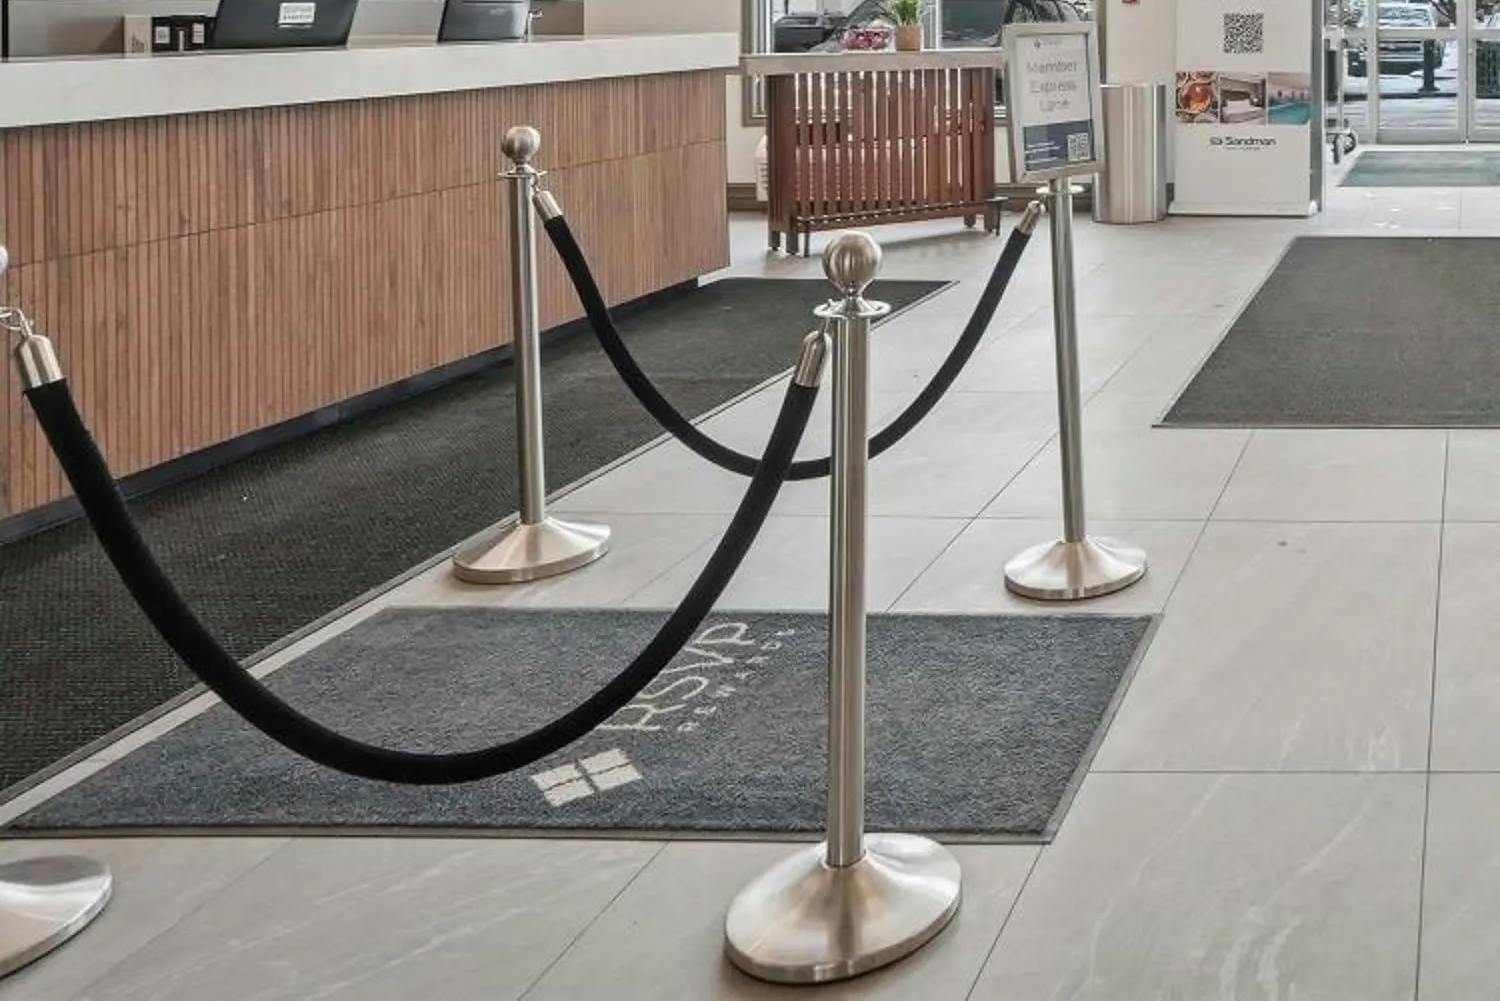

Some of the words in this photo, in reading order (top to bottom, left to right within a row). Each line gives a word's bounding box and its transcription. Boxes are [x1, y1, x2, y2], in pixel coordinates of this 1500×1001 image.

[1026, 60, 1077, 74] Member
[1030, 79, 1077, 96] Express
[1039, 99, 1071, 112] Lane
[1225, 136, 1277, 146] Sandman
